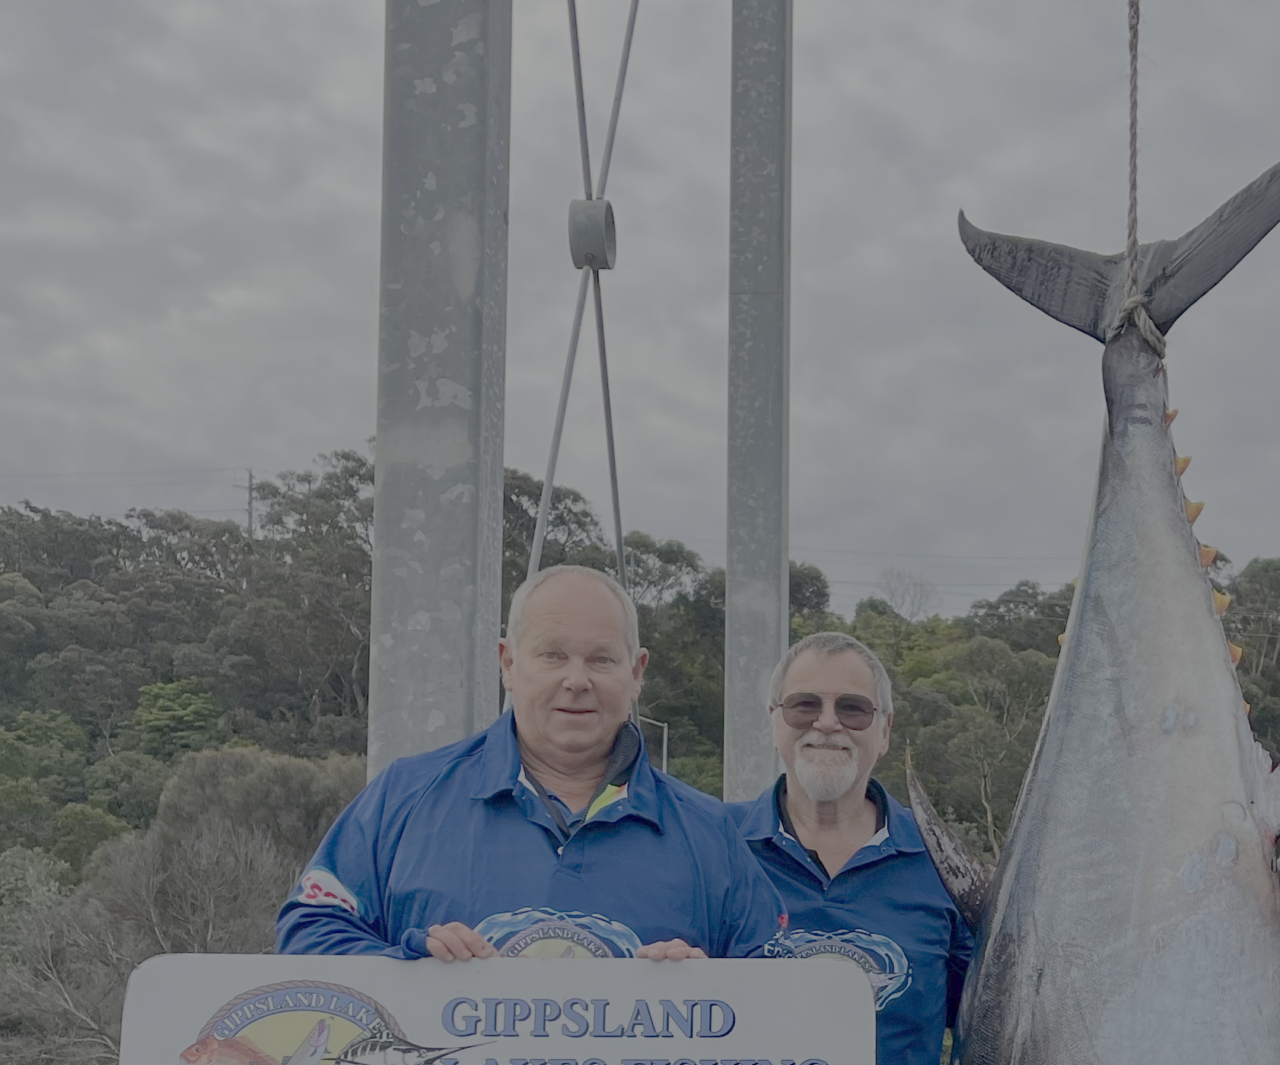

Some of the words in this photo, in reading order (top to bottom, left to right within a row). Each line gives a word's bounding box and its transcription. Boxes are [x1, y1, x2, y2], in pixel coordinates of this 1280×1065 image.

[507, 928, 572, 958] GIPPSLAND
[796, 944, 840, 959] PPSLAND
[213, 992, 325, 1041] GIPPSLAND
[329, 996, 394, 1042] LAKES
[441, 997, 736, 1038] GIPPSLAND
